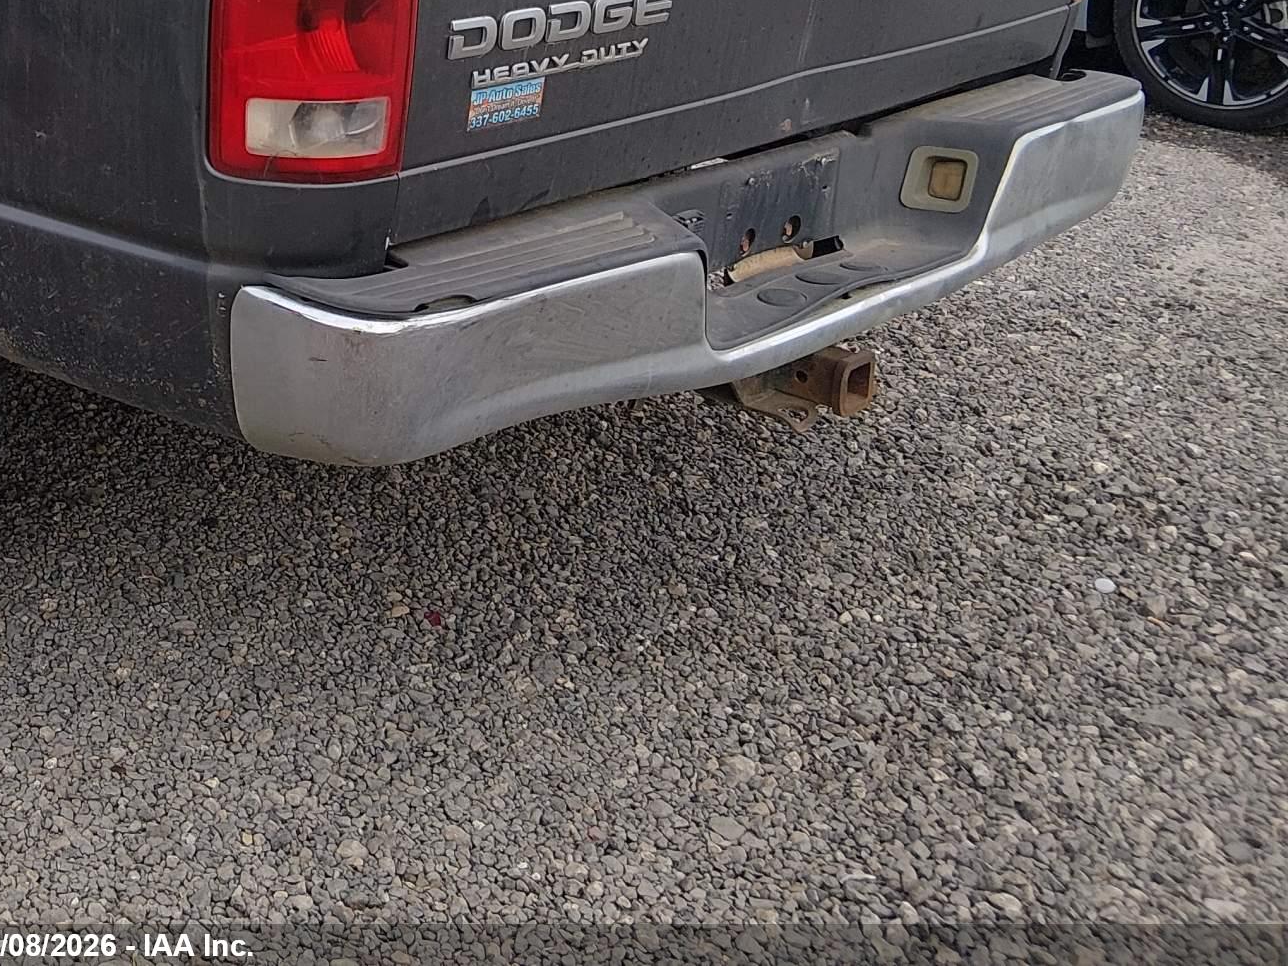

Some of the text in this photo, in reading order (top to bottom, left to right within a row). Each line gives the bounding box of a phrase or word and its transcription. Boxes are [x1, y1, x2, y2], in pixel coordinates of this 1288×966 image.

[472, 37, 649, 88] HEAVY DUTY
[473, 91, 487, 105] JP
[488, 87, 513, 102] Auto
[515, 82, 541, 97] Sales
[470, 104, 539, 129] 337-602-6455
